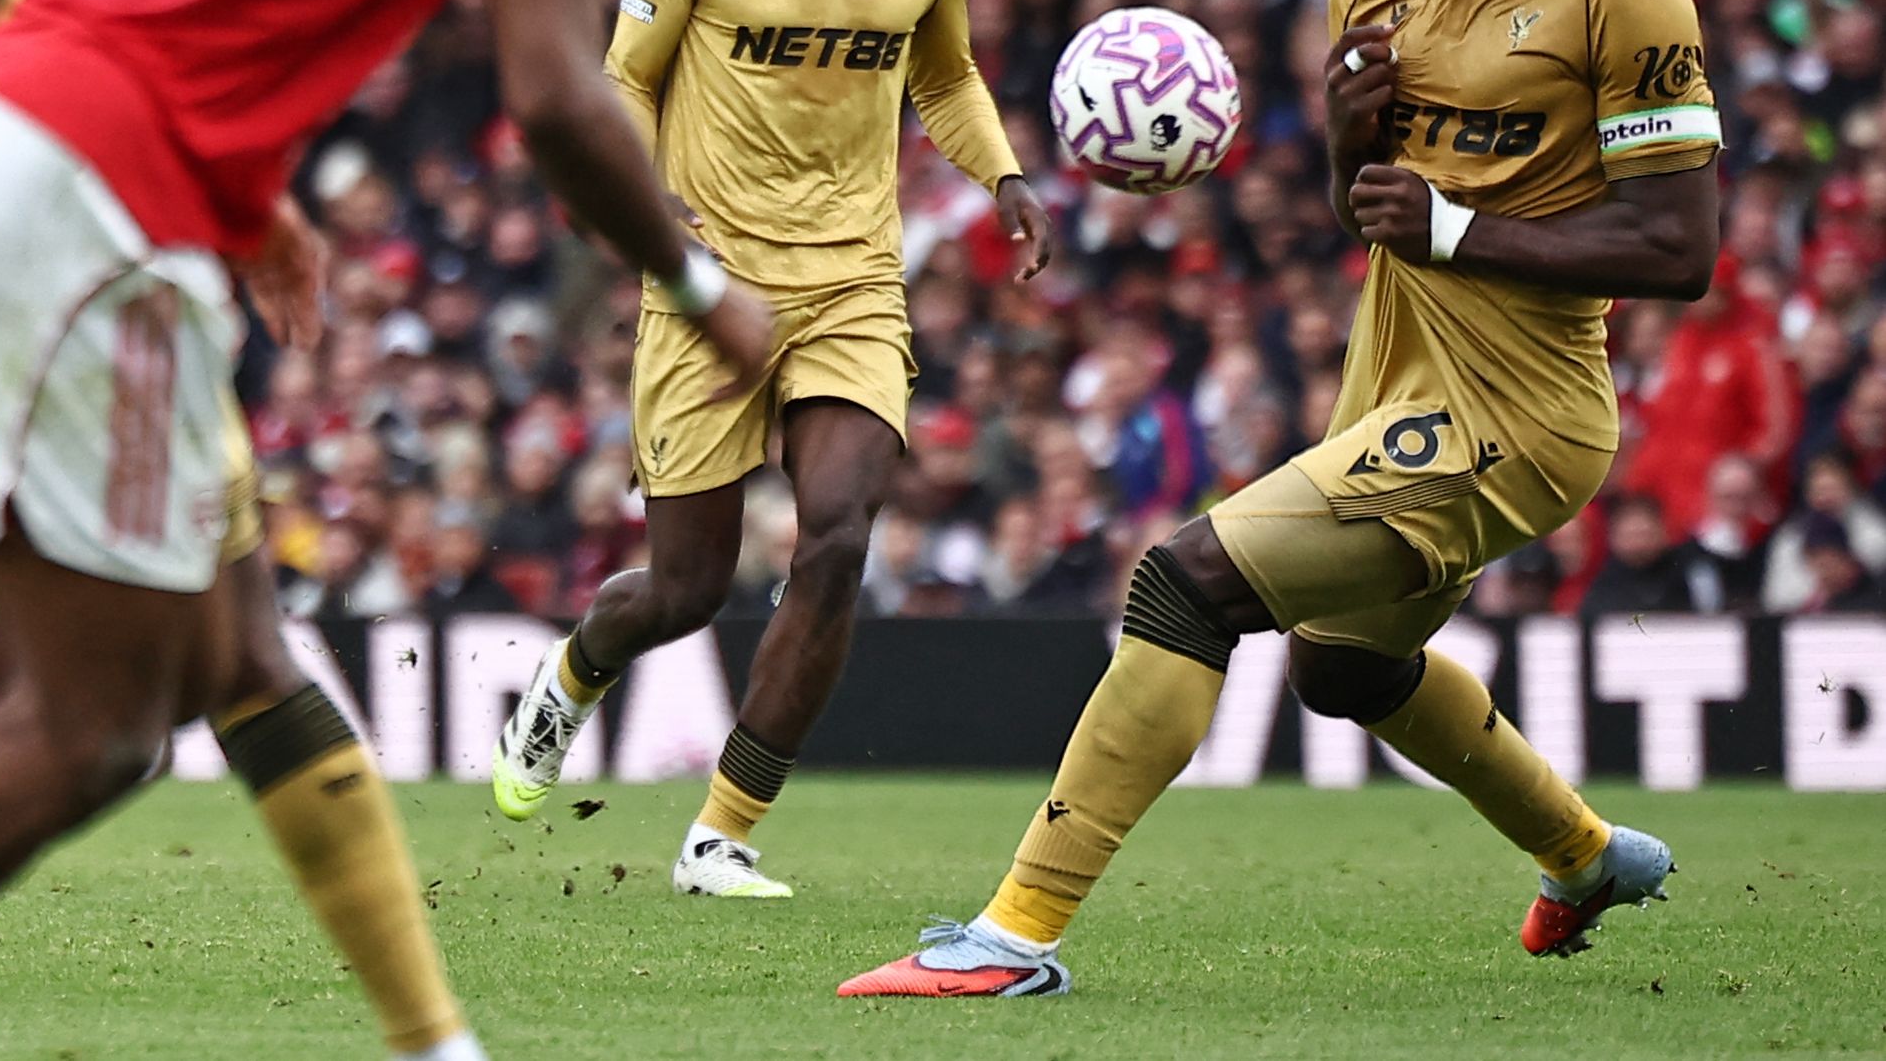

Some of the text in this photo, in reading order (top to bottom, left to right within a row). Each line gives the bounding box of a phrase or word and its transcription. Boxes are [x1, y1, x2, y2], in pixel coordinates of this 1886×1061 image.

[729, 25, 910, 70] NET88
[1380, 102, 1547, 156] ET88
[1599, 117, 1672, 148] ptain
[1382, 411, 1452, 469] 6
